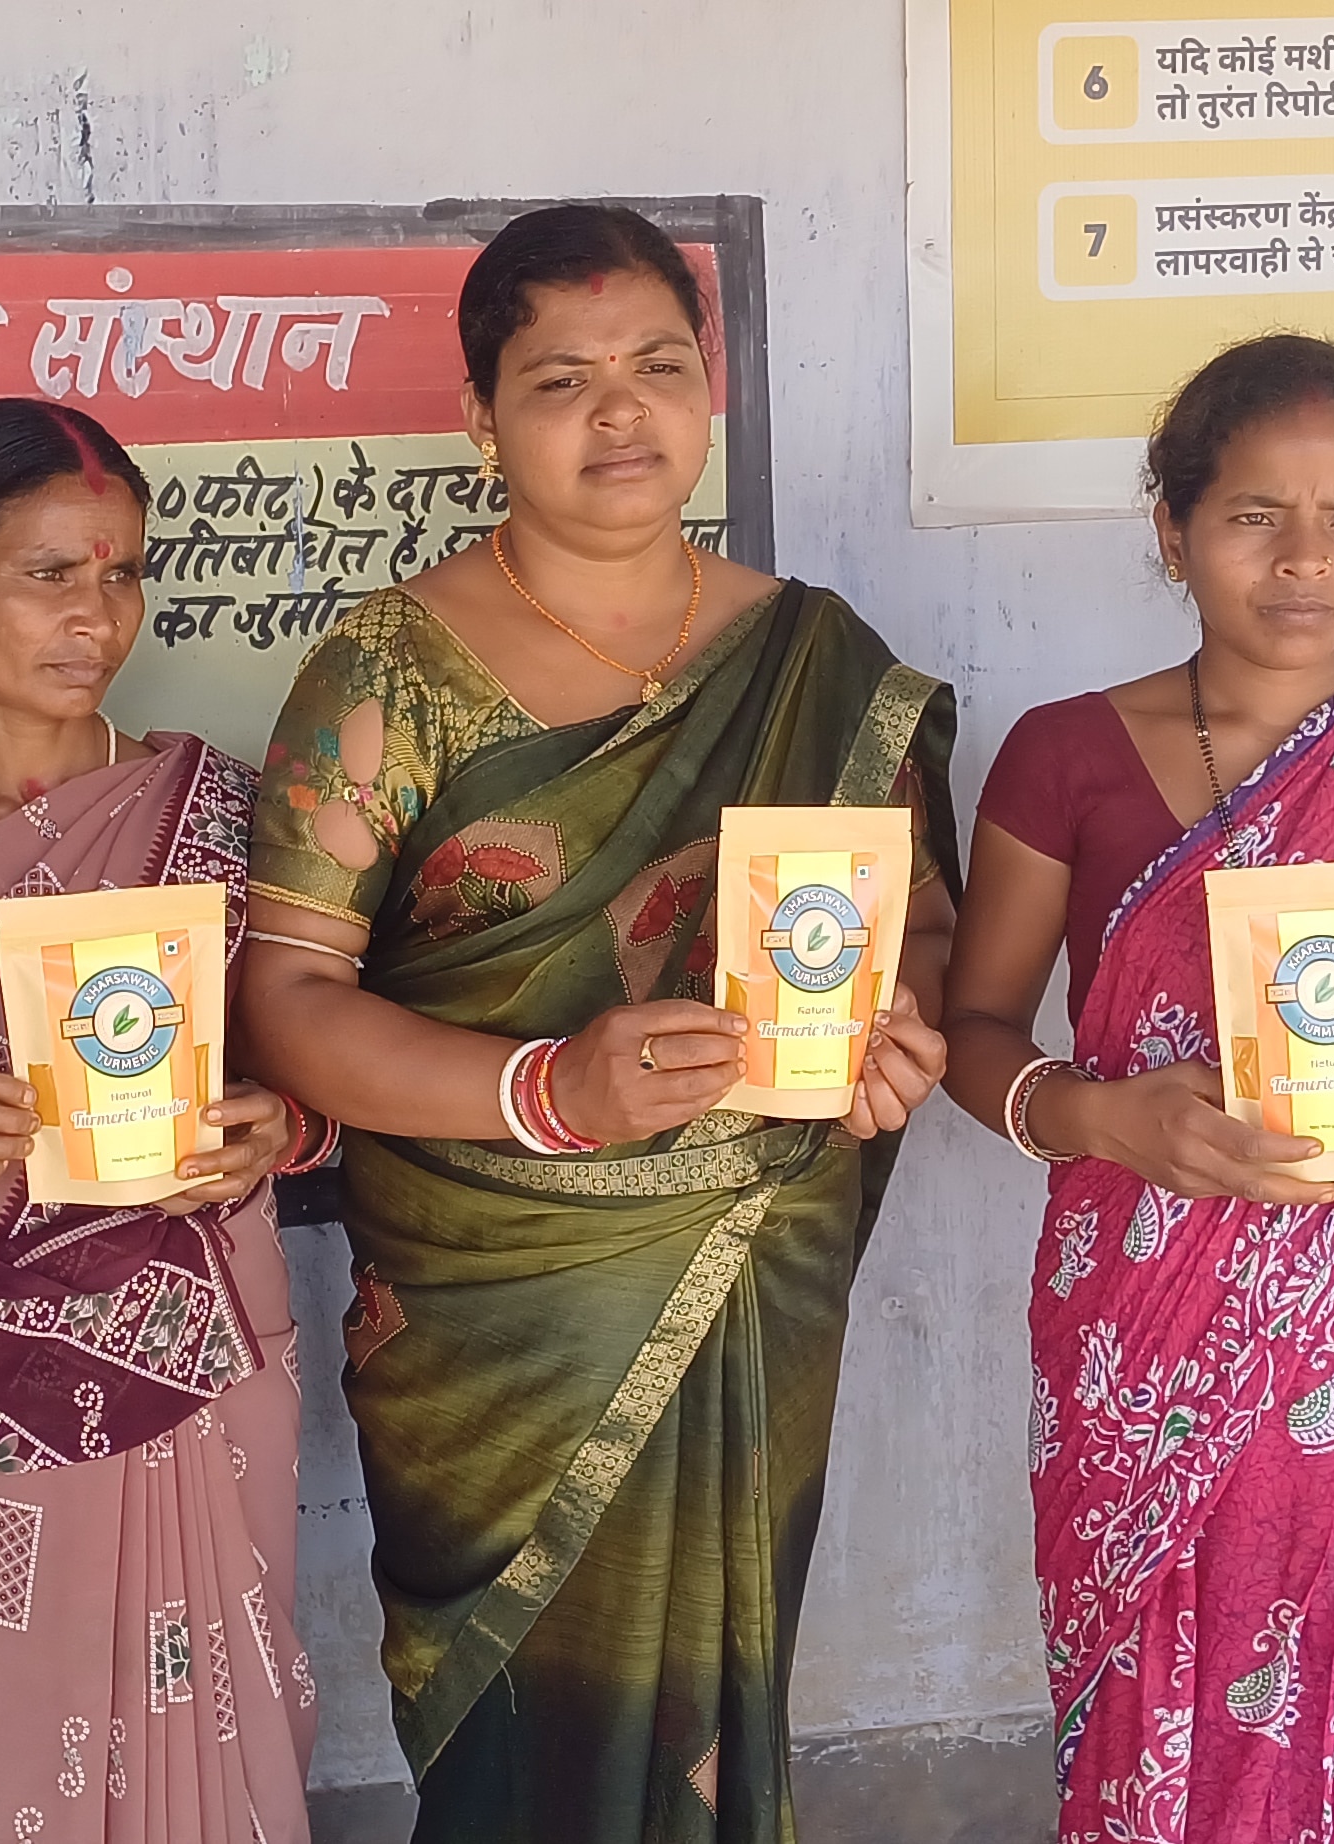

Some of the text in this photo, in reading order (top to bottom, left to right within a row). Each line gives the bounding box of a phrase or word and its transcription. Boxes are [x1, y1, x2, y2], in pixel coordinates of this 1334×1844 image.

[1156, 37, 1210, 75] यदि
[1218, 36, 1276, 75] कोई
[1083, 66, 1109, 100] 6
[1156, 84, 1190, 120] तो
[1197, 84, 1257, 129] तुरंत
[1155, 197, 1291, 232] प्रसंस्करण
[1083, 224, 1107, 257] 7
[1155, 237, 1290, 278] लापरवाही
[1298, 236, 1324, 271] से
[31, 266, 390, 399] संस्थान
[333, 440, 376, 519] के
[153, 597, 236, 649] का
[783, 890, 849, 918] KHARSAWAN
[83, 972, 159, 1005] KHARSAWAN
[790, 965, 846, 986] TURMERIC
[95, 1045, 160, 1071] TURMERIC
